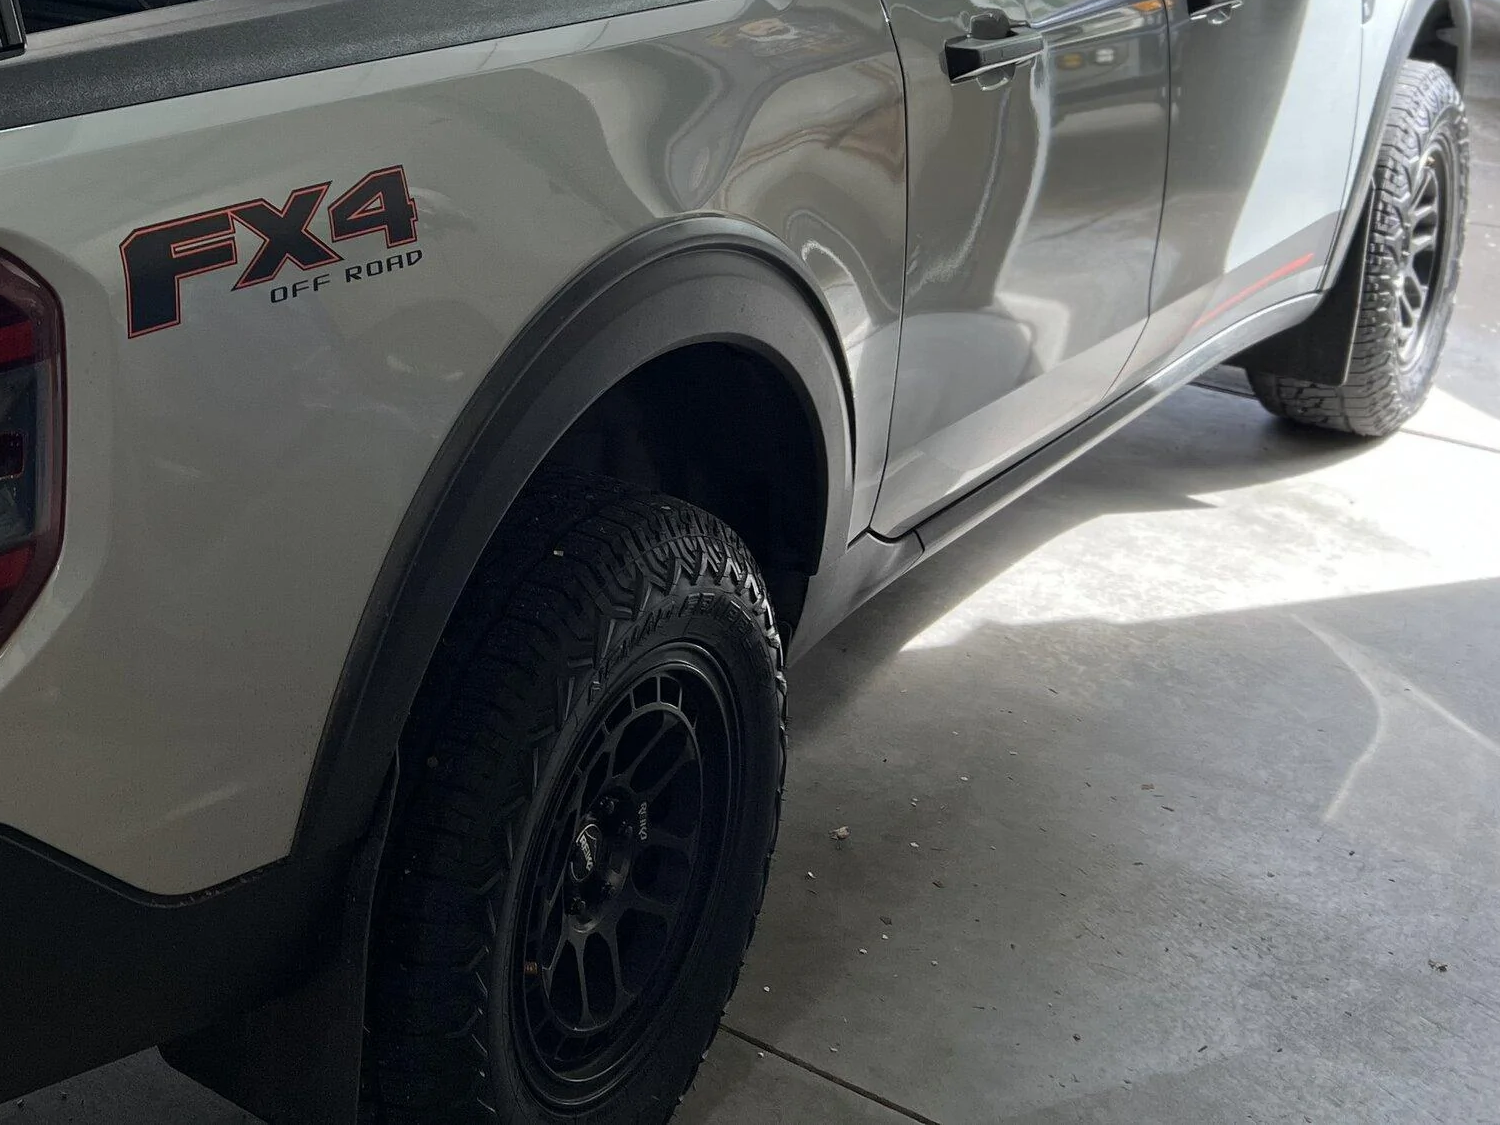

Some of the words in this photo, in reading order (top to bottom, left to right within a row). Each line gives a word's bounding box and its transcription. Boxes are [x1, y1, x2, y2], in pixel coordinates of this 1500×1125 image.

[119, 164, 418, 339] FX4
[270, 273, 331, 303] OFF
[345, 249, 423, 283] ROAD
